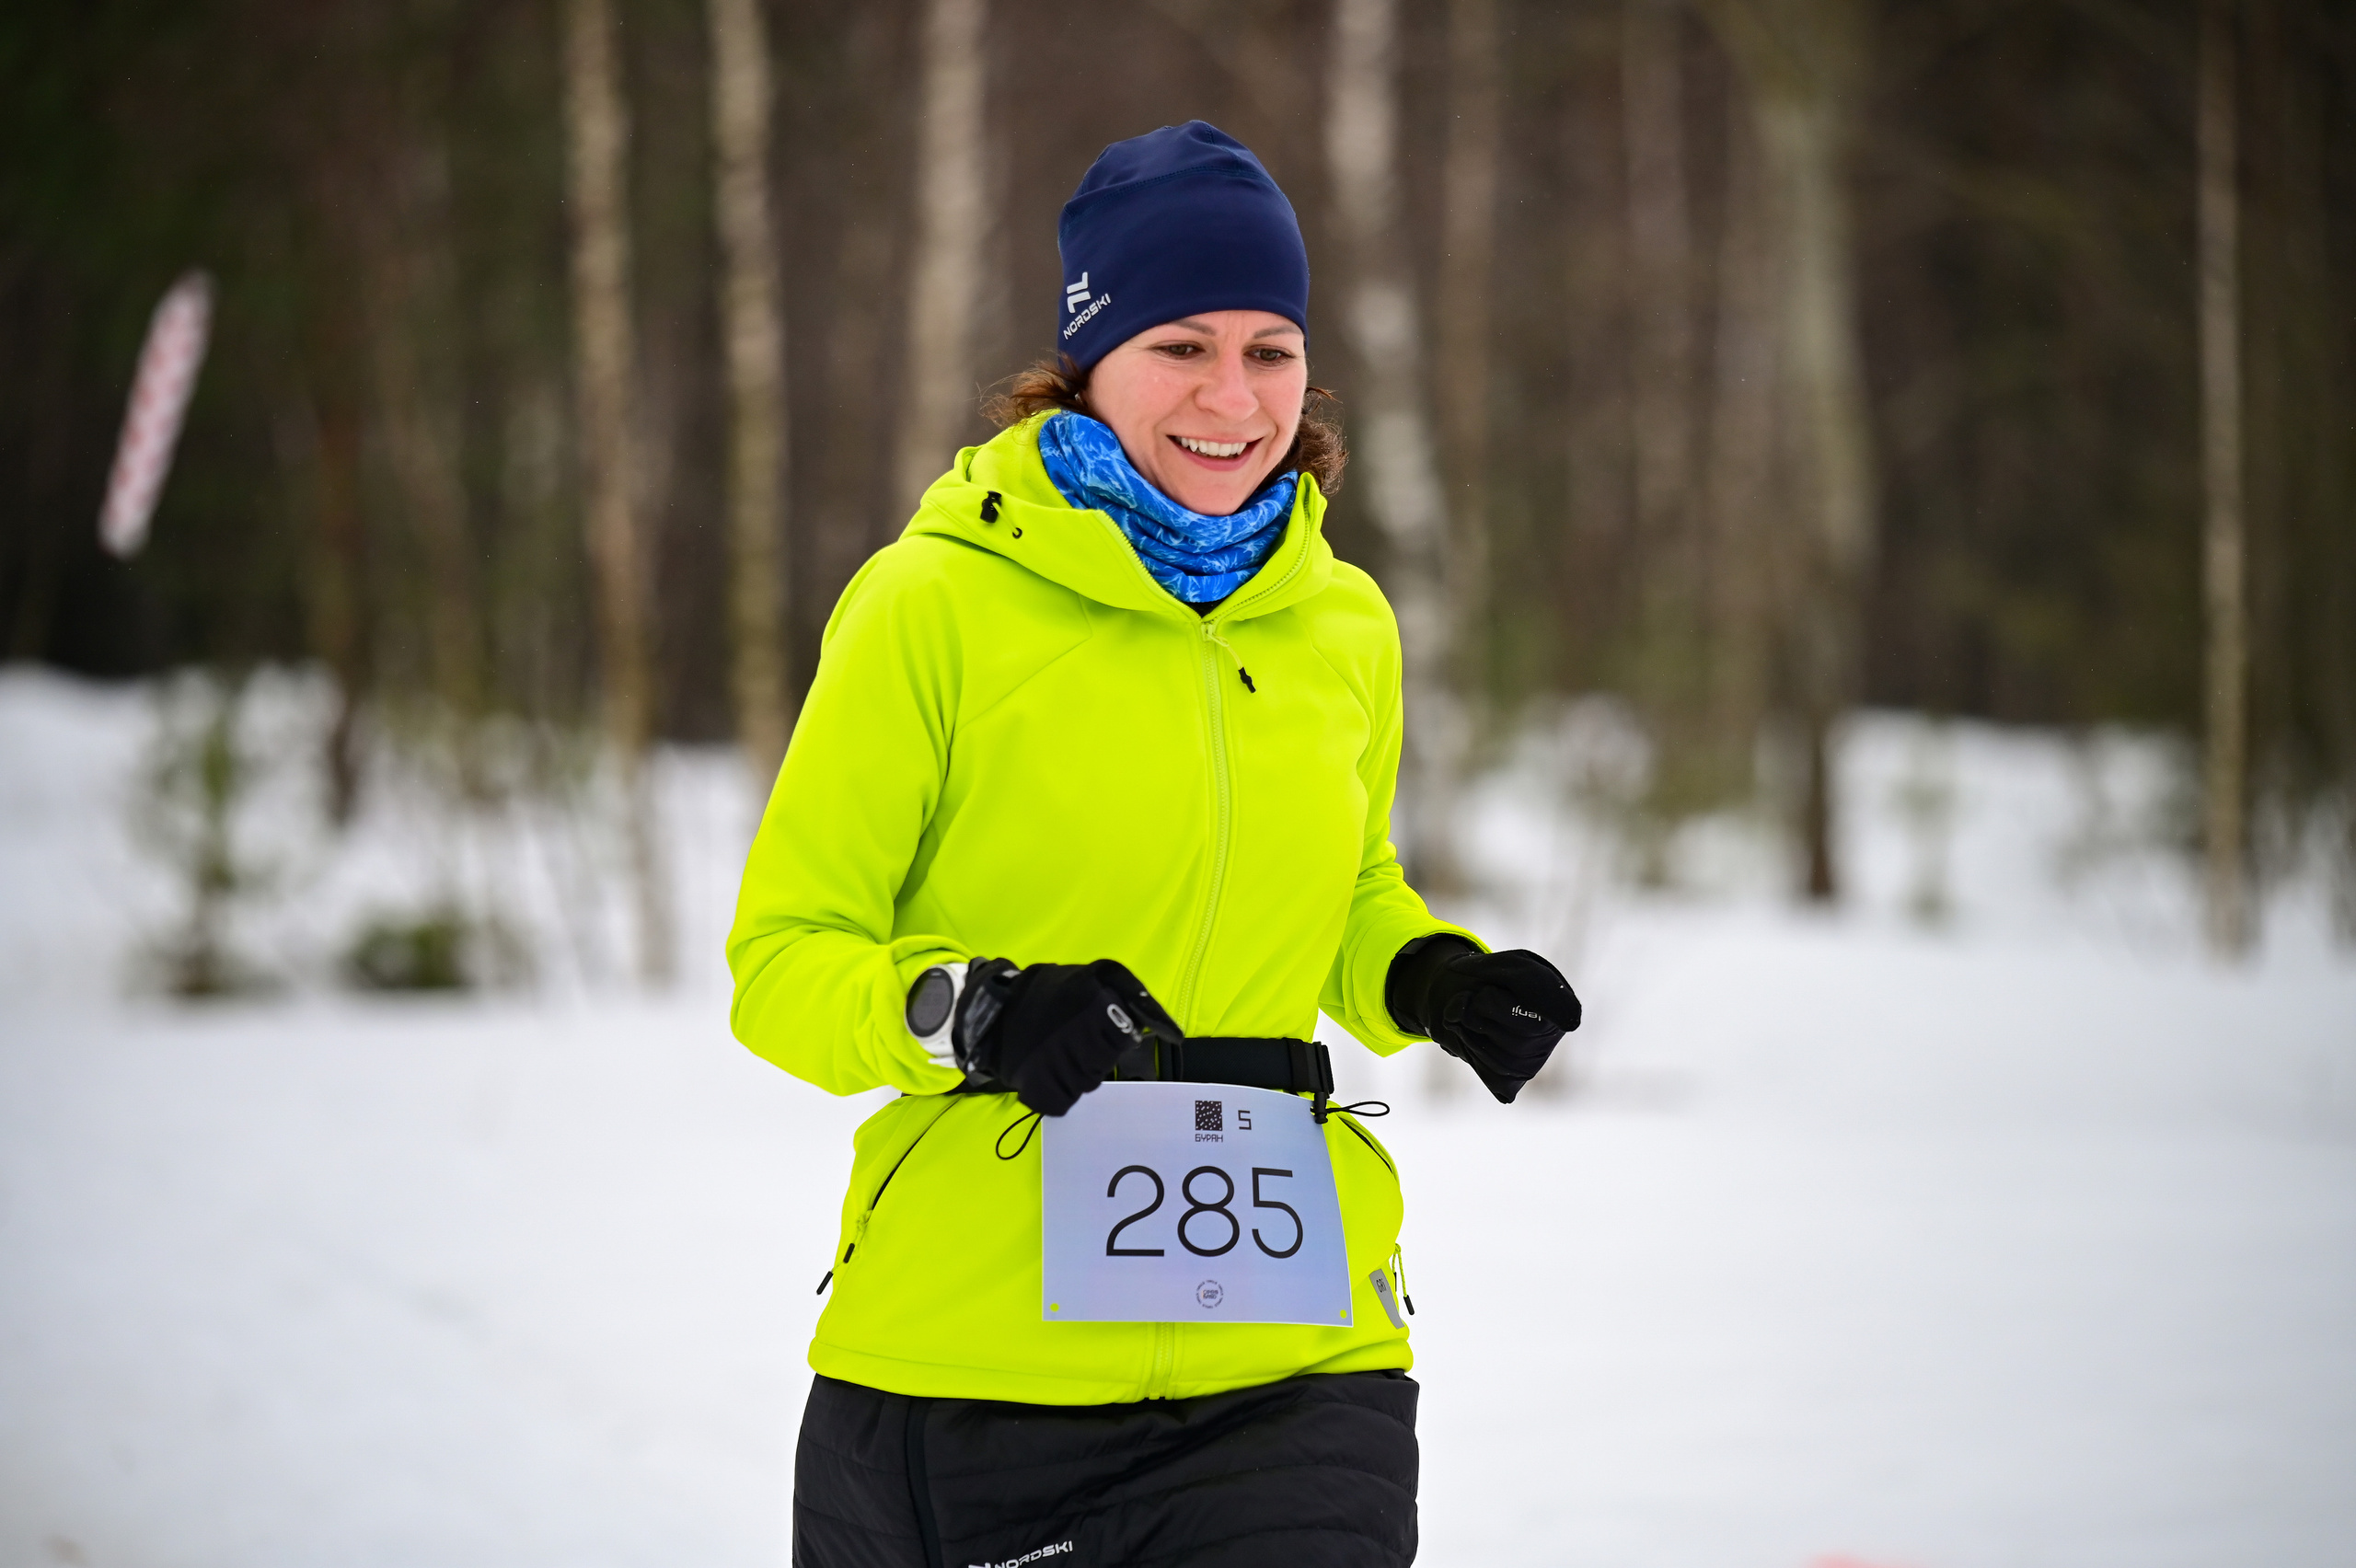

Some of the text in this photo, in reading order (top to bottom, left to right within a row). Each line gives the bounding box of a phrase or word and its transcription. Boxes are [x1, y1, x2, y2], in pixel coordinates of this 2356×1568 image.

[1063, 293, 1112, 340] NORDSKI
[1237, 1110, 1253, 1131] 5
[1195, 1133, 1224, 1143] БУРАН
[1105, 1165, 1304, 1259] 285
